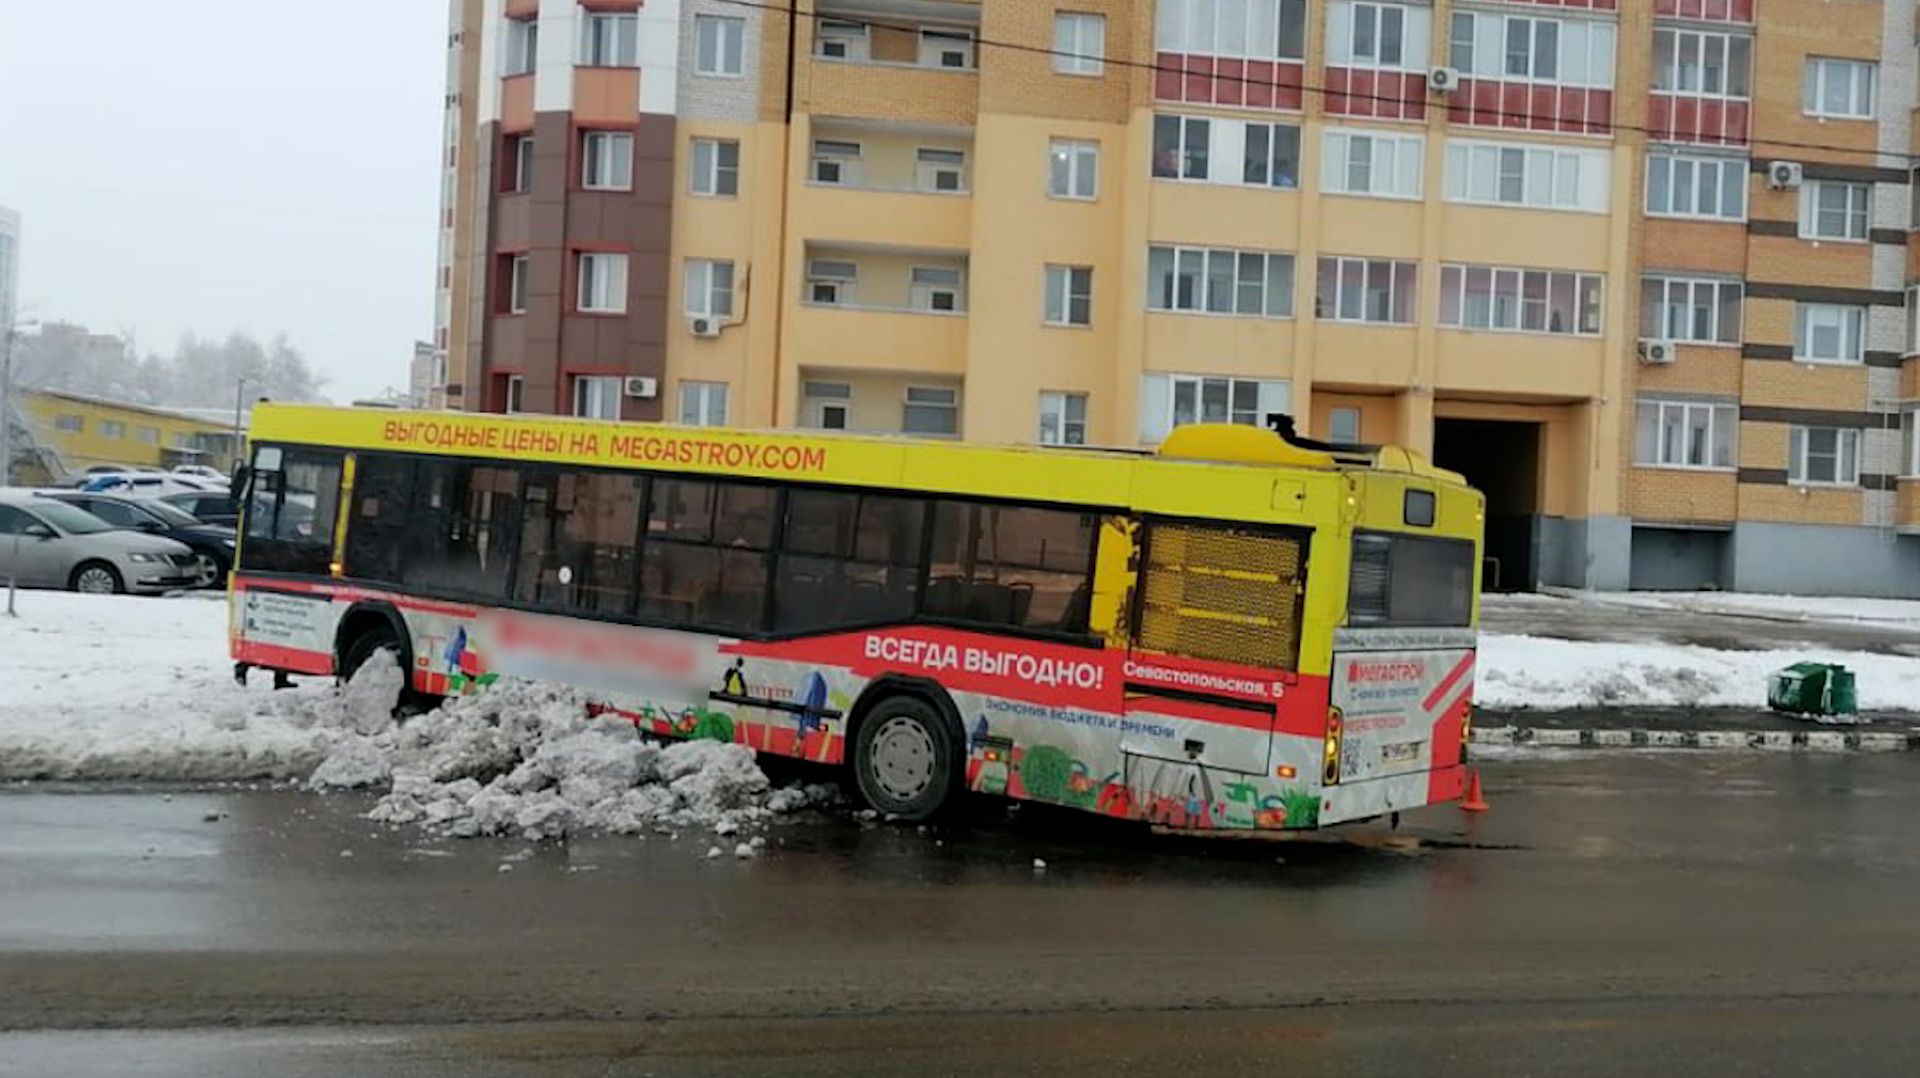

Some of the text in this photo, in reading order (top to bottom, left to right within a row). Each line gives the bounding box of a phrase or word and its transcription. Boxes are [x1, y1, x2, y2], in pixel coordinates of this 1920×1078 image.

[385, 420, 826, 472] ВЫГОДНЫЕ ЦЕНЫ НА MEGASTROY.COM
[865, 635, 1104, 690] ВСЕГДА ВЫГОДНО!
[1271, 681, 1284, 698] 5
